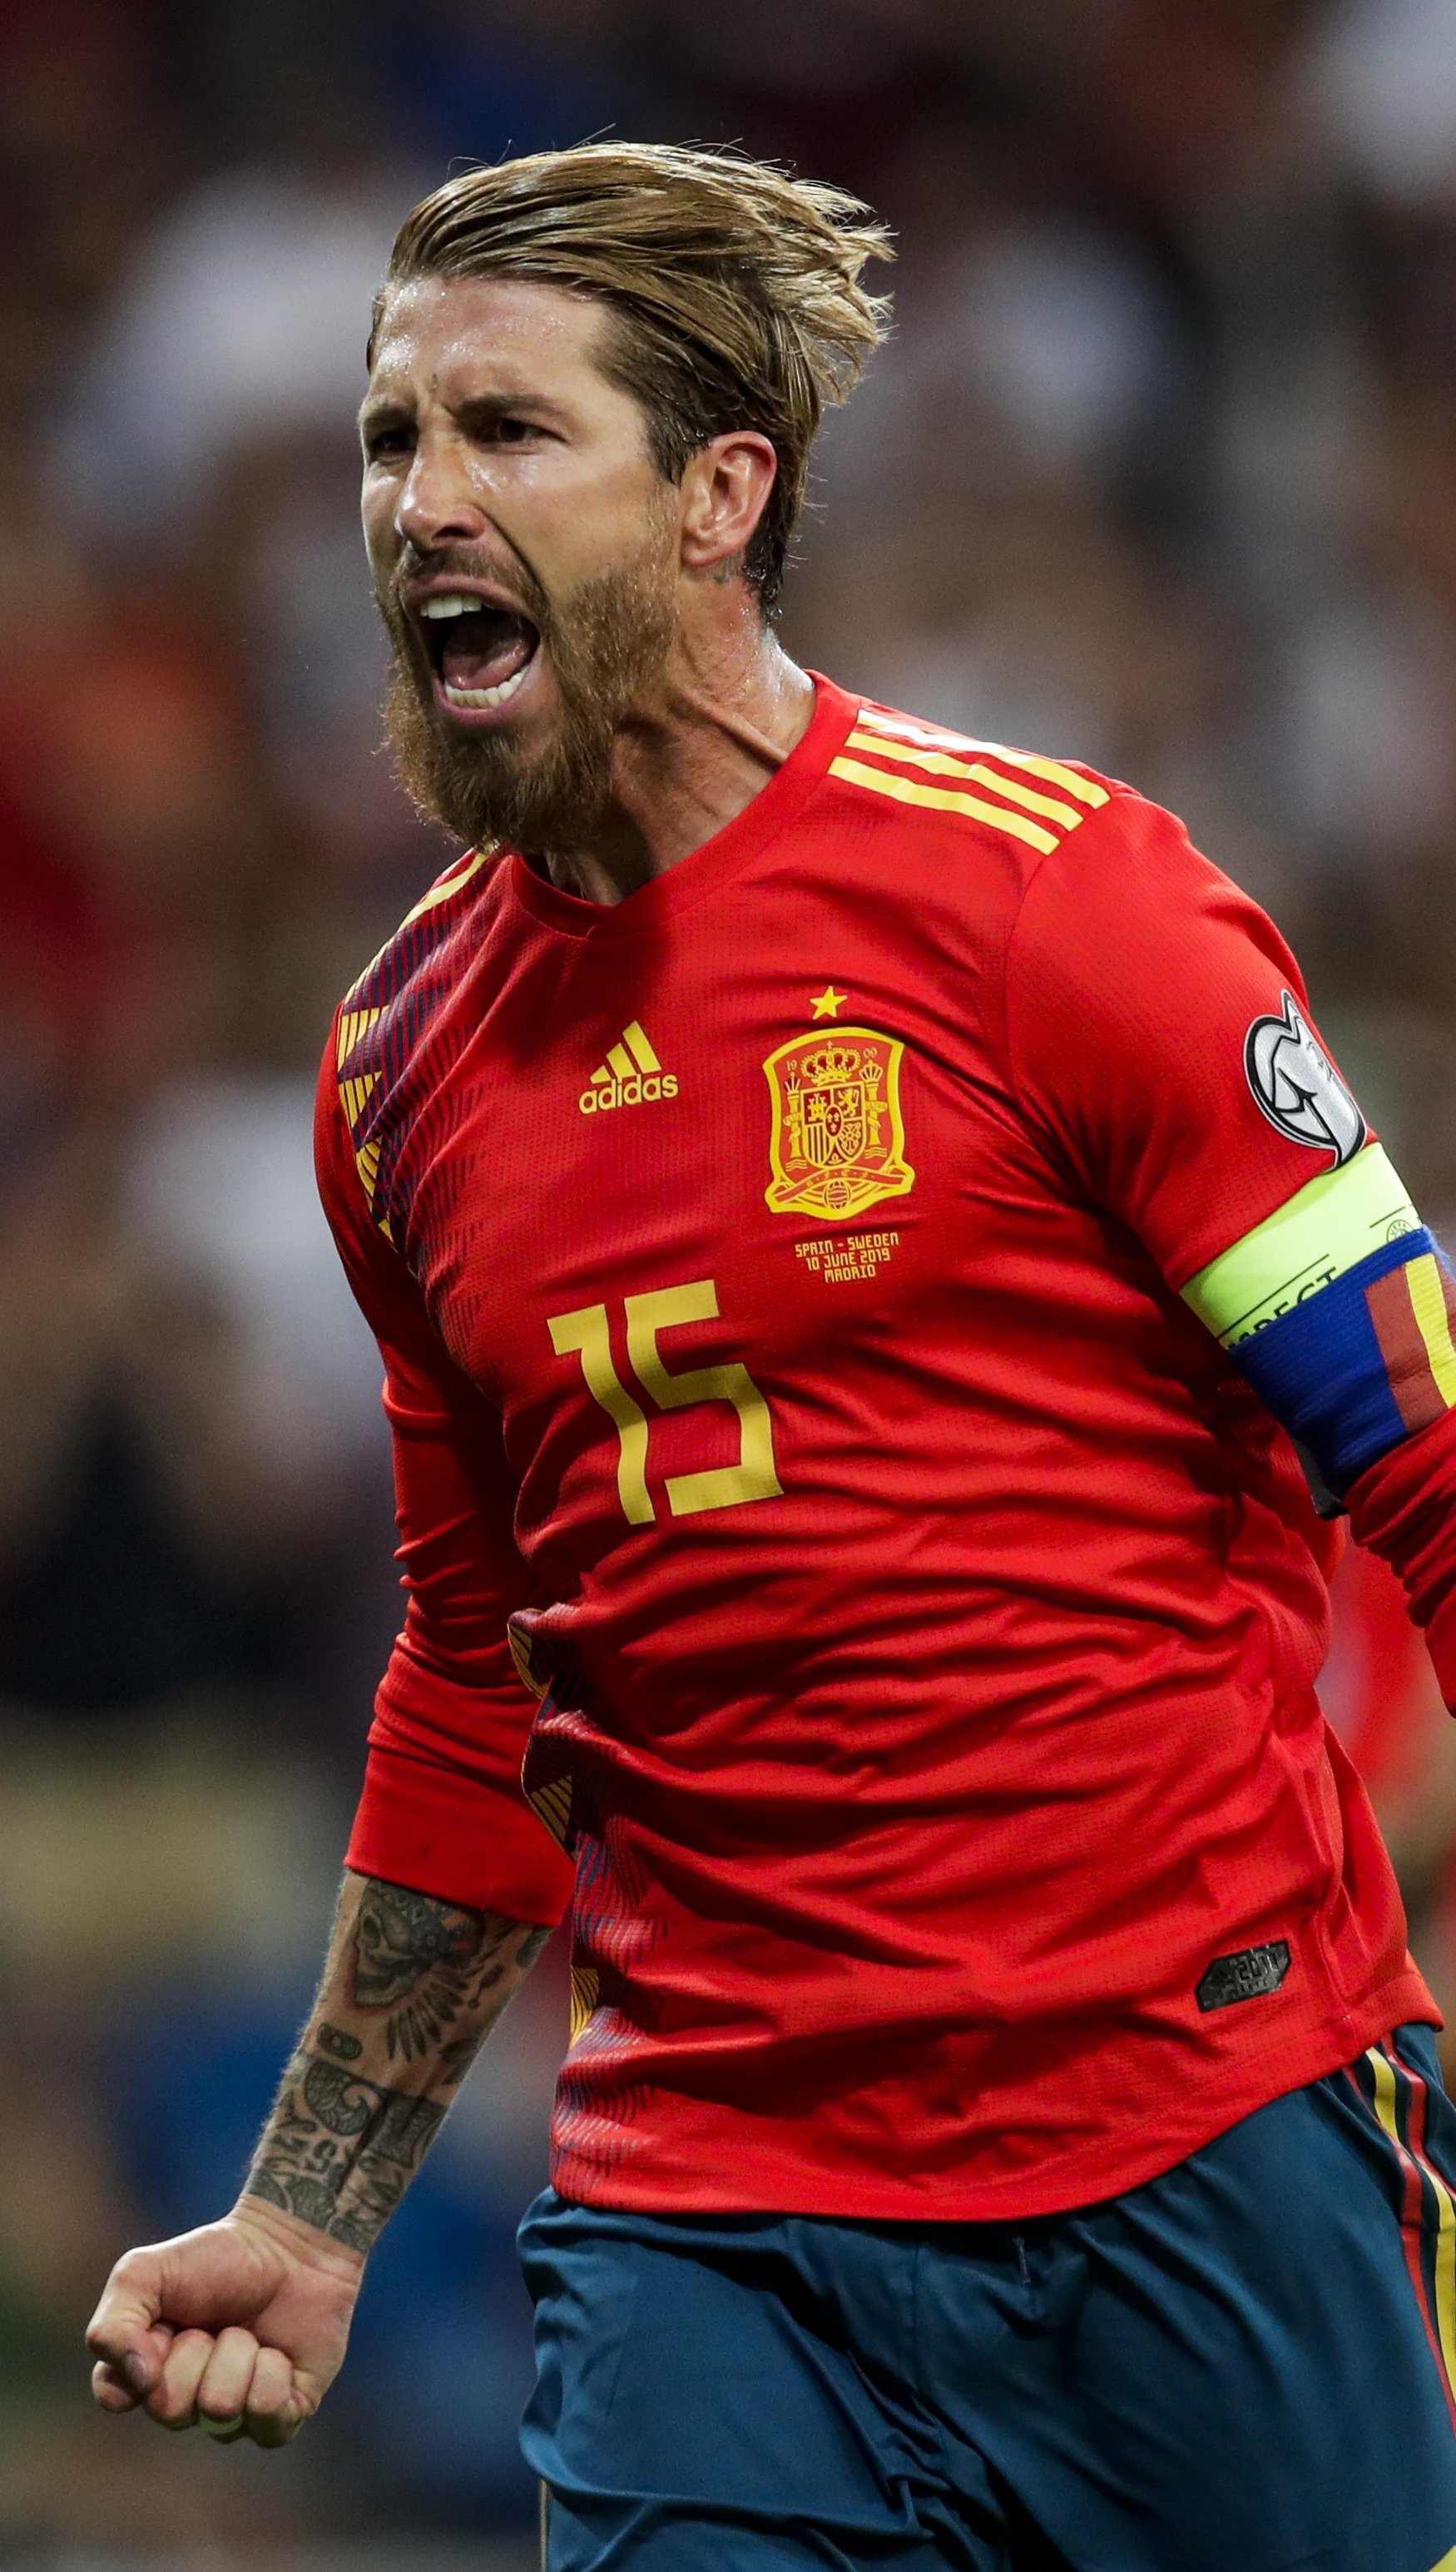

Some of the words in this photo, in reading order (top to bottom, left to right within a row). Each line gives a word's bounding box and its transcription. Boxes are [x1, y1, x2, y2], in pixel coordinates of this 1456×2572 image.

[578, 1073, 680, 1114] adidas
[795, 1240, 834, 1258] SPAIN
[847, 1231, 899, 1251] SWEDEN
[805, 1257, 820, 1271] 10
[823, 1251, 857, 1268] JUNE
[859, 1248, 891, 1264] 2019
[824, 1264, 876, 1283] MADRID
[547, 1279, 785, 1525] 15
